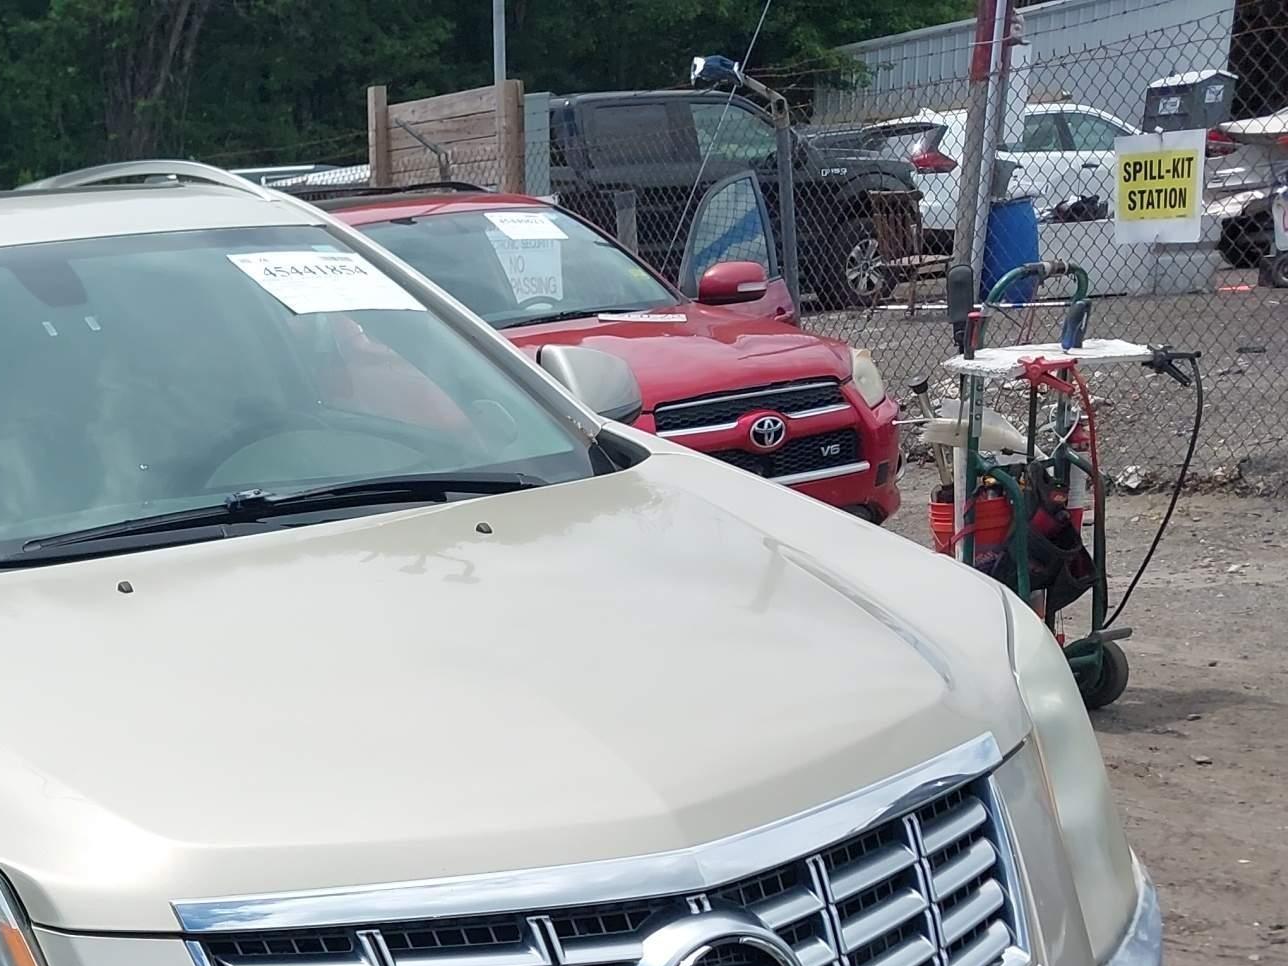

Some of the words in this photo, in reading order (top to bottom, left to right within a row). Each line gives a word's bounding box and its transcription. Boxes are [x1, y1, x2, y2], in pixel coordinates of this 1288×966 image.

[1123, 157, 1194, 182] SPILL-KIT
[1127, 187, 1187, 211] STATION
[263, 264, 368, 278] 45441854
[820, 444, 840, 457] V6
